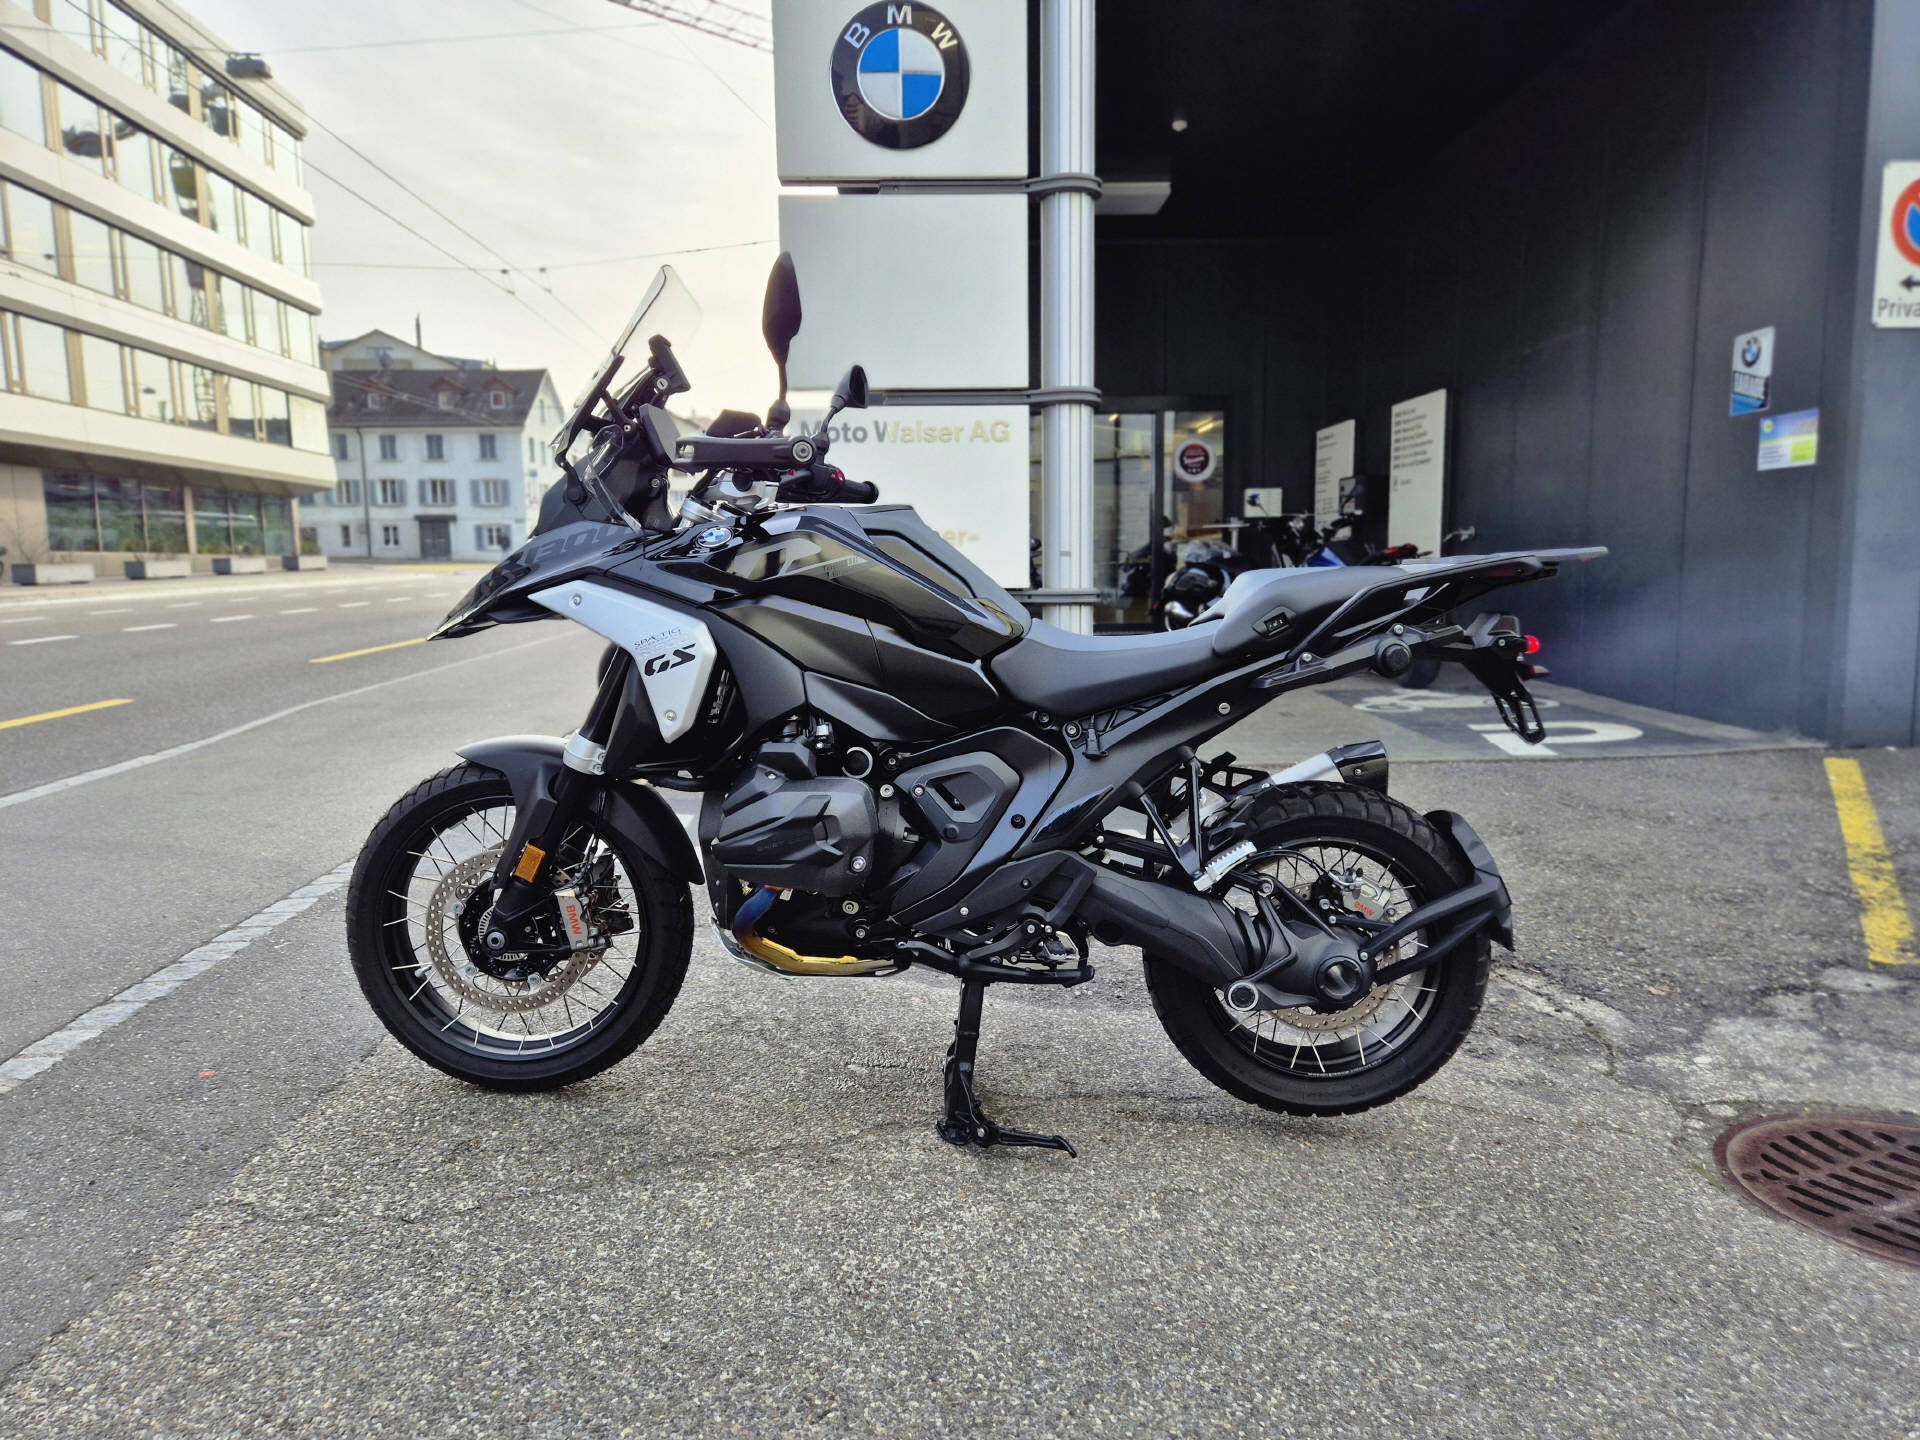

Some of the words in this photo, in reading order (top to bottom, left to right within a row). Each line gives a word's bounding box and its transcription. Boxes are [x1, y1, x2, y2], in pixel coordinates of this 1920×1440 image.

[843, 3, 958, 49] BMW
[801, 420, 868, 443] Moto
[874, 420, 964, 443] Walser
[969, 420, 1010, 443] AG
[644, 642, 696, 676] GS
[565, 904, 583, 935] BMW
[1354, 900, 1375, 916] BMW
